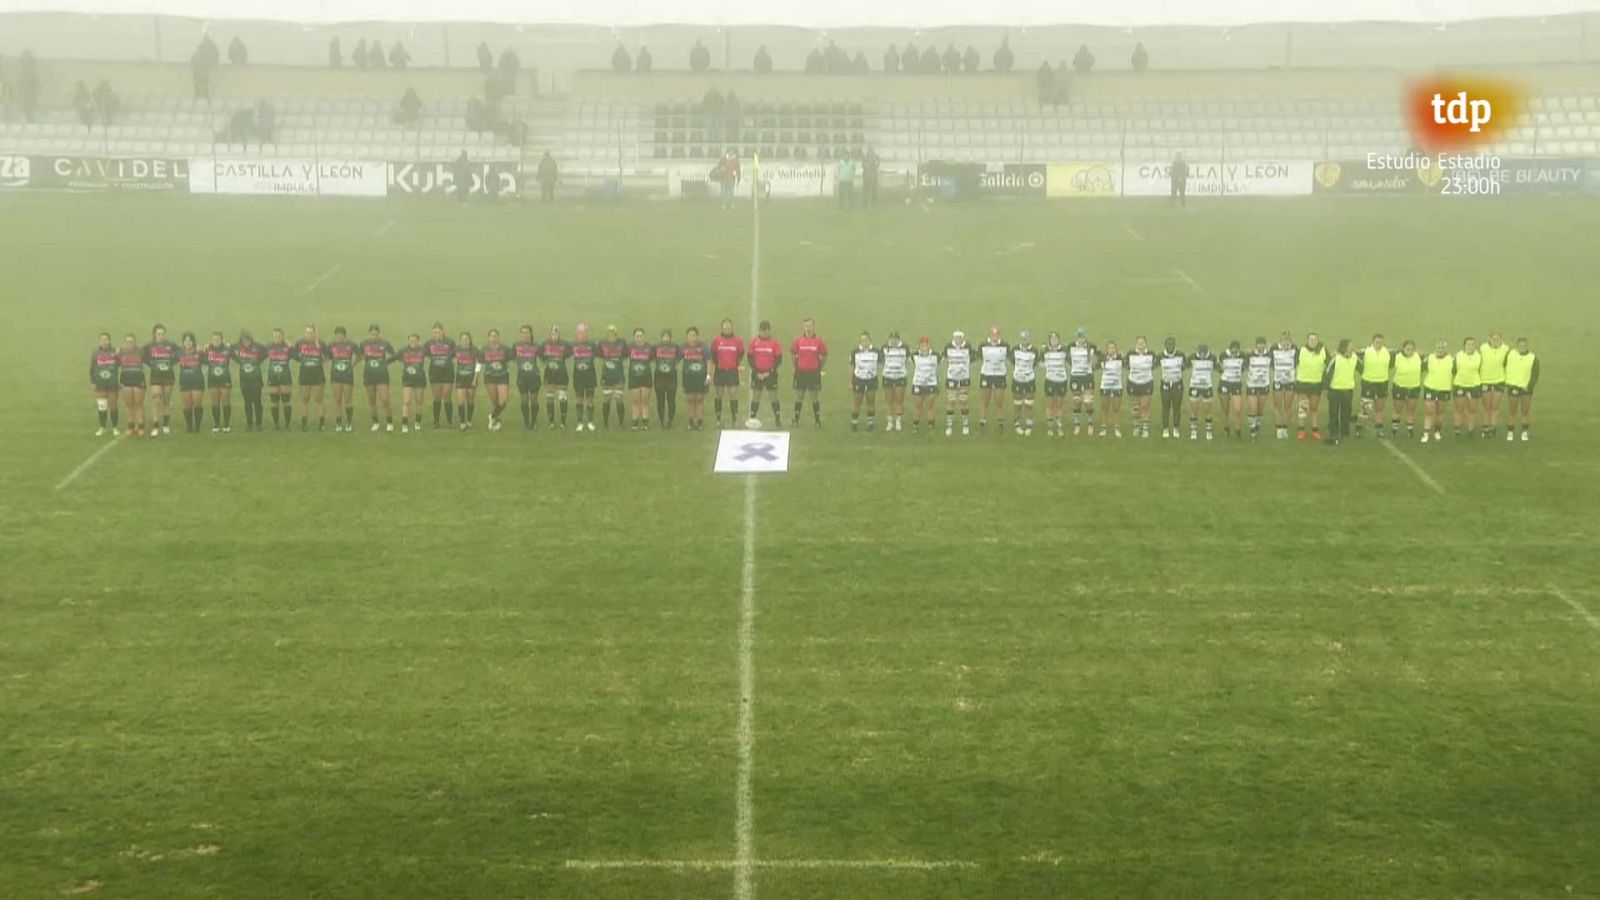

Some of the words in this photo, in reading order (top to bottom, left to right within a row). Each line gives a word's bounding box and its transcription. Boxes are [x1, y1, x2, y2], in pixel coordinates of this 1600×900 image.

[54, 158, 188, 179] CAVIDEL
[215, 163, 293, 177] CASTILLA
[302, 163, 312, 181] Y
[320, 160, 363, 180] LEÓN
[1139, 165, 1217, 180] CASLLA
[1227, 165, 1238, 181] Y
